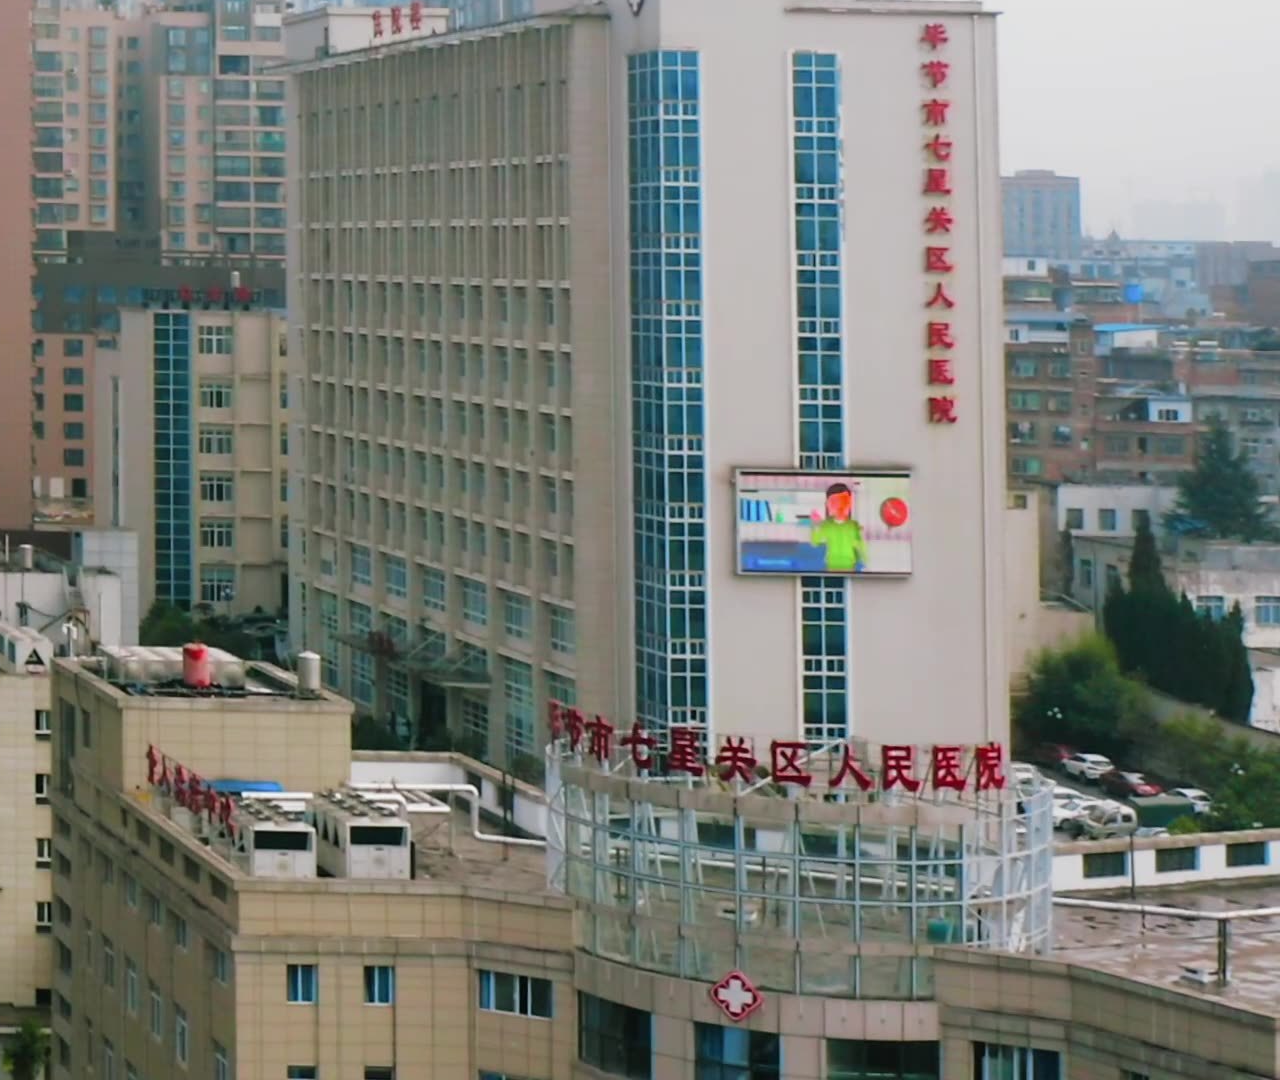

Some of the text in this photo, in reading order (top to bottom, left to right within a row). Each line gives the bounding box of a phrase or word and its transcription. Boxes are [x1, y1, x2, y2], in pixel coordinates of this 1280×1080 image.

[919, 23, 958, 423] 毕节市七星关区人民医院
